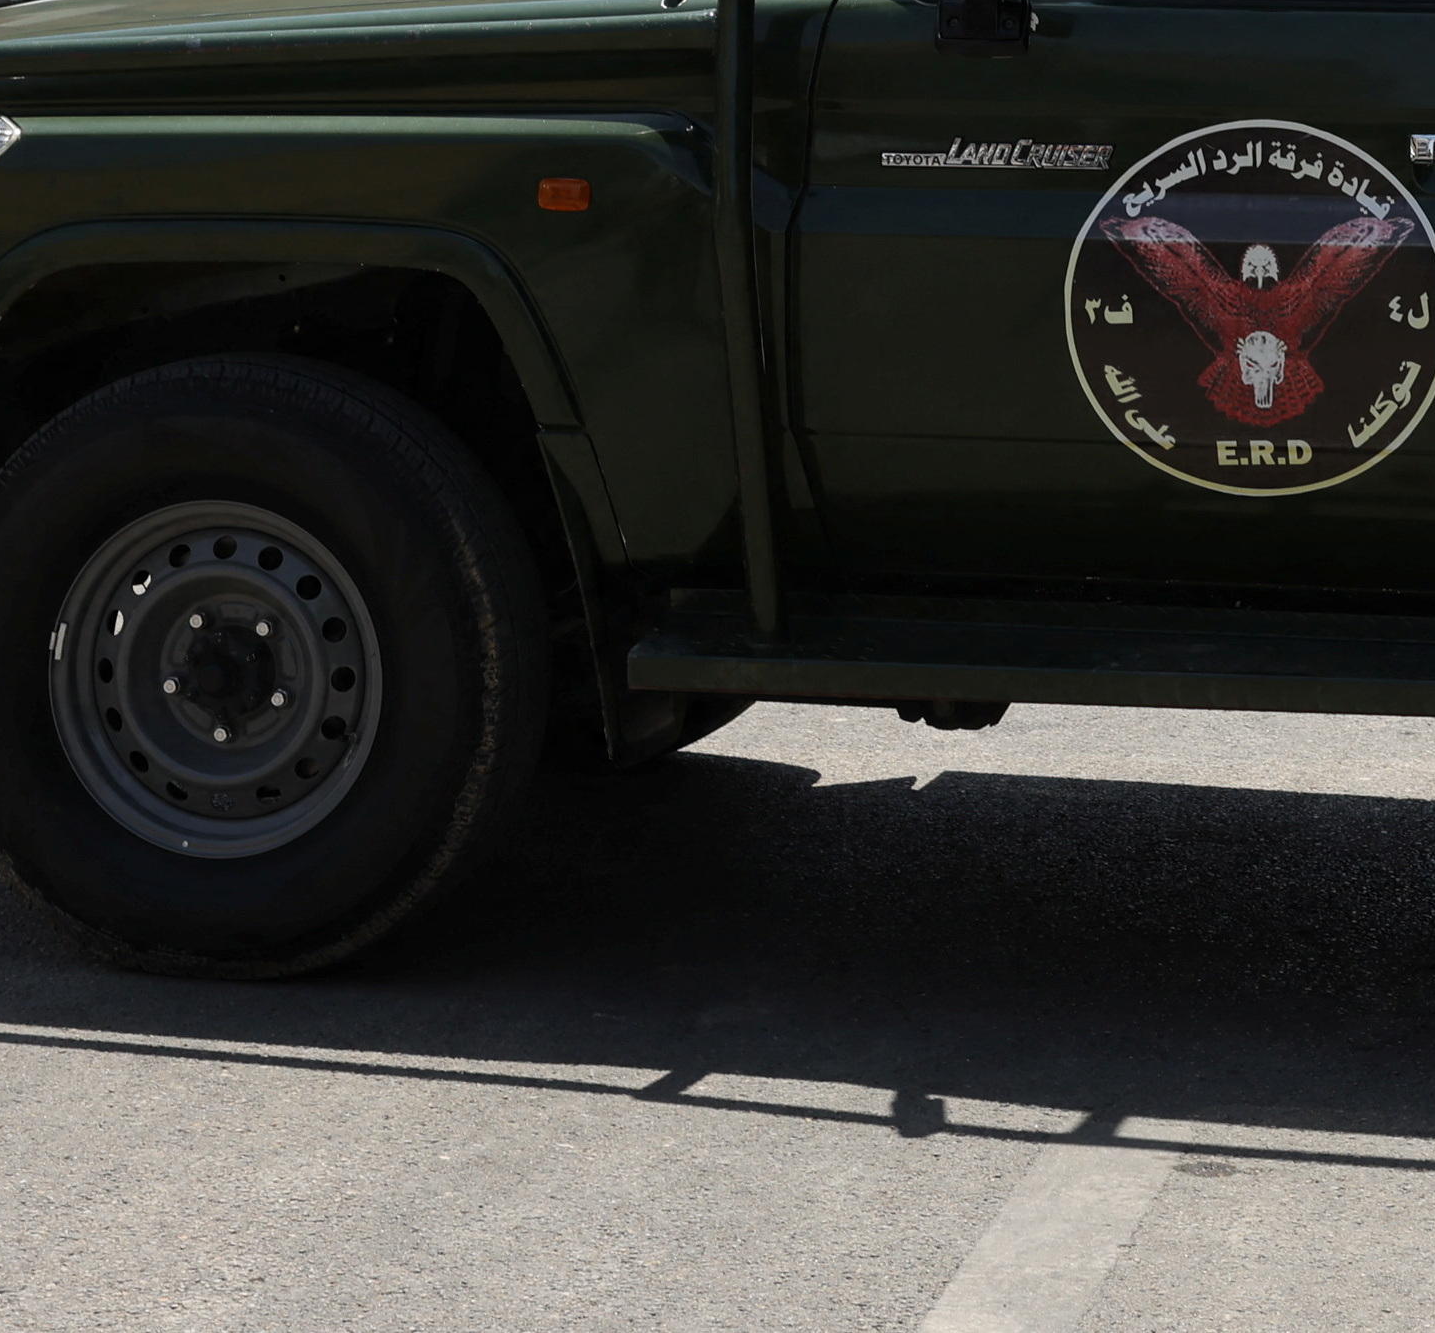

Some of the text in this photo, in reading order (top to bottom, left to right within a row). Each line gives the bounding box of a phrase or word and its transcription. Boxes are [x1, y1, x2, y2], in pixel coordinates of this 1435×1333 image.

[884, 154, 942, 166] TOYOTA
[1122, 140, 1396, 221] قيادة فرقة الرد السريع
[1104, 364, 1142, 403] الله
[1347, 361, 1422, 449] توكلنا
[1216, 439, 1313, 466] E.R.D
